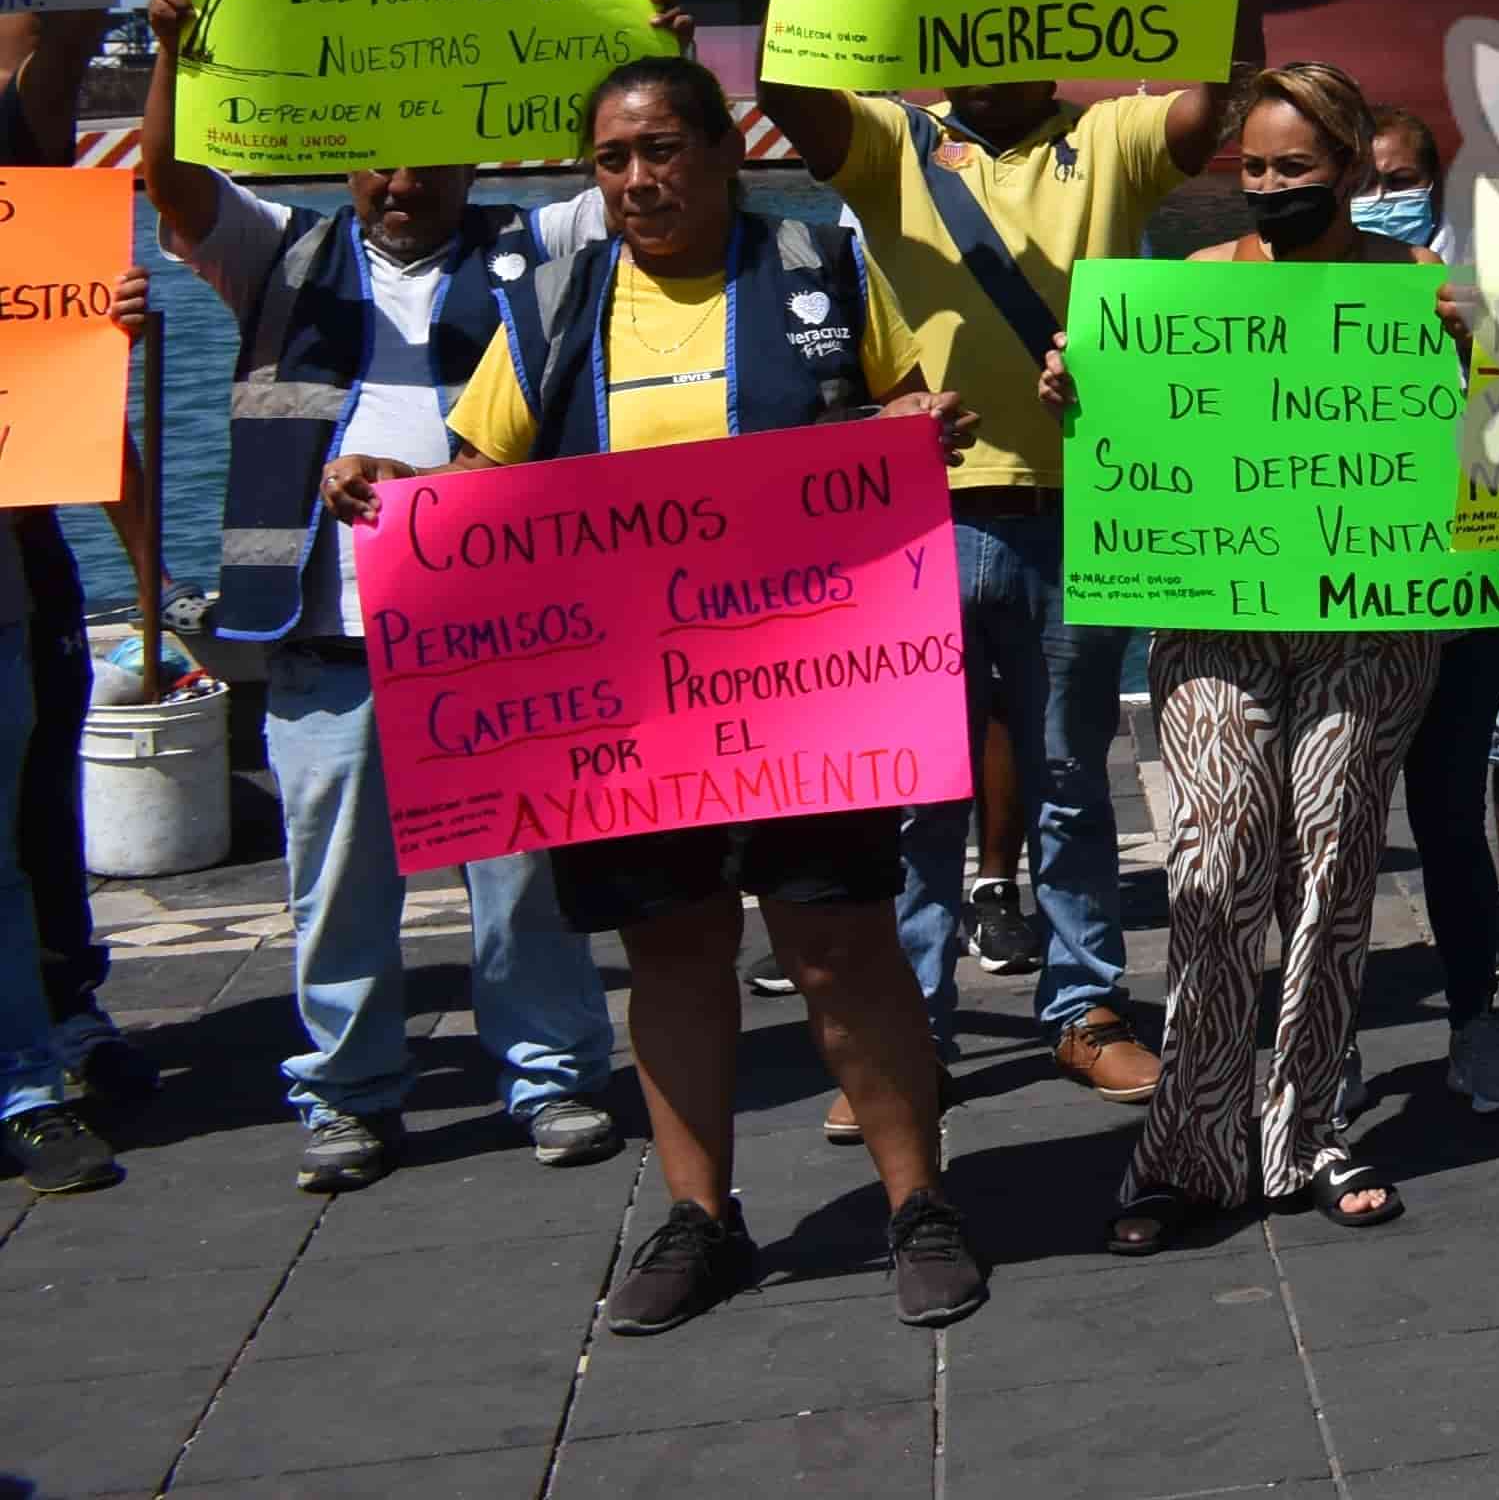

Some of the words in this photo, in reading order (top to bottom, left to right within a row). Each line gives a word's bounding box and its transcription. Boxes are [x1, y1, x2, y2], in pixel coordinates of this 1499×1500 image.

[318, 33, 481, 77] NUESTRAS
[508, 27, 631, 64] VENTAS
[918, 3, 1180, 74] INGRESOS
[218, 96, 382, 124] DEPENDEN
[398, 99, 444, 118] DEL
[302, 134, 347, 147] UNIDO
[1099, 293, 1287, 355] NUESTRA
[1169, 382, 1222, 420] DE
[1094, 437, 1192, 494] SOLO
[1233, 451, 1417, 492] DEPENDE
[410, 487, 727, 573] CONTAMOS
[800, 456, 892, 519] CON
[1094, 520, 1280, 557] NUESTRAS
[667, 561, 854, 624] CHALECOS
[905, 546, 925, 589] Y
[1232, 580, 1280, 617] EL
[661, 632, 967, 714] PROPORCIONADOS
[568, 736, 642, 782] POR
[715, 720, 765, 757] EL
[506, 747, 919, 850] AYUNTAMIENTO
